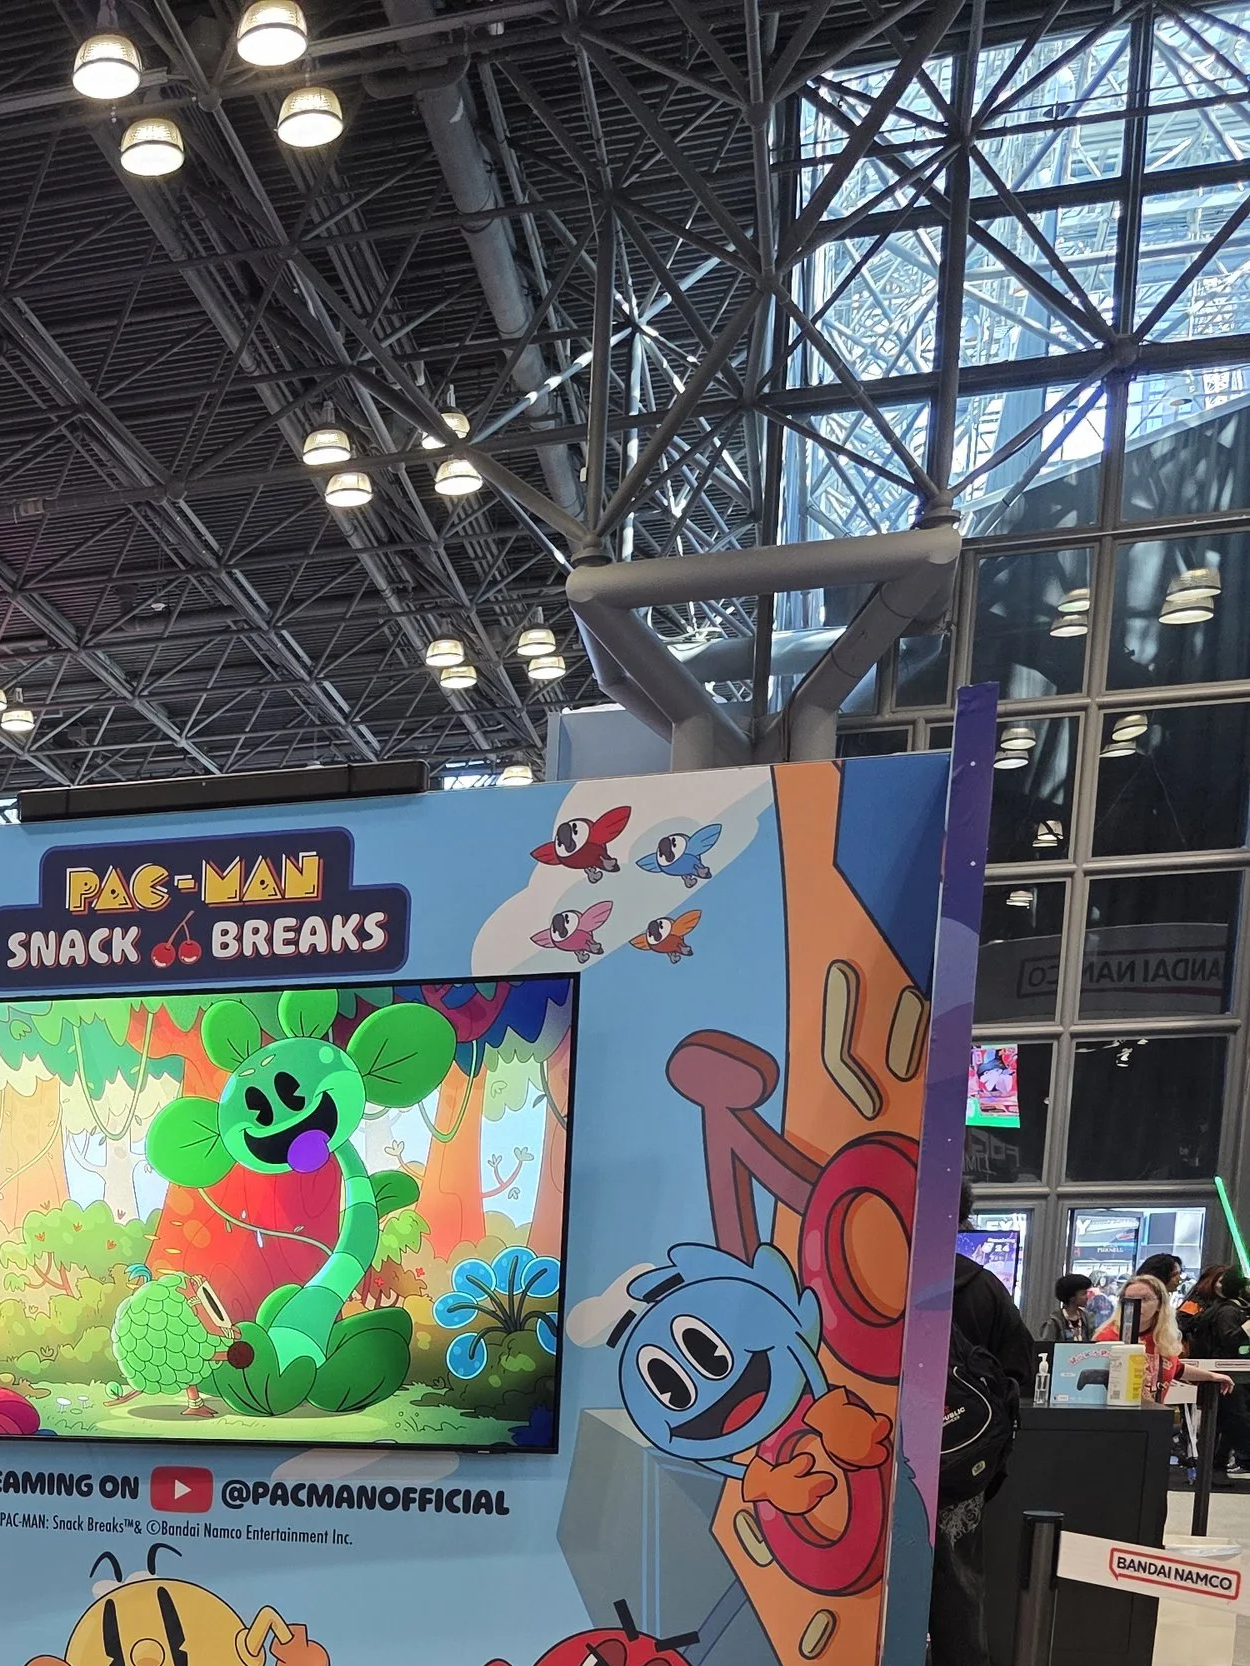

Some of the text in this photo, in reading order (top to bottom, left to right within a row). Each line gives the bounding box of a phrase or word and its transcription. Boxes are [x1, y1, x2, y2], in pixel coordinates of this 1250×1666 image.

[64, 850, 324, 915] PAC-MAN
[7, 911, 388, 969] SNACK BREAKS
[99, 1475, 140, 1500] ON
[221, 1479, 511, 1516] @PACMANOFFICIAL
[0, 1512, 49, 1530] PAC-MAN:
[52, 1514, 84, 1531] Snack
[203, 1523, 242, 1540] Namco
[246, 1525, 329, 1545] Entertainment
[332, 1528, 353, 1545] Inc.
[1116, 1555, 1234, 1592] BANDAI NAMCO
